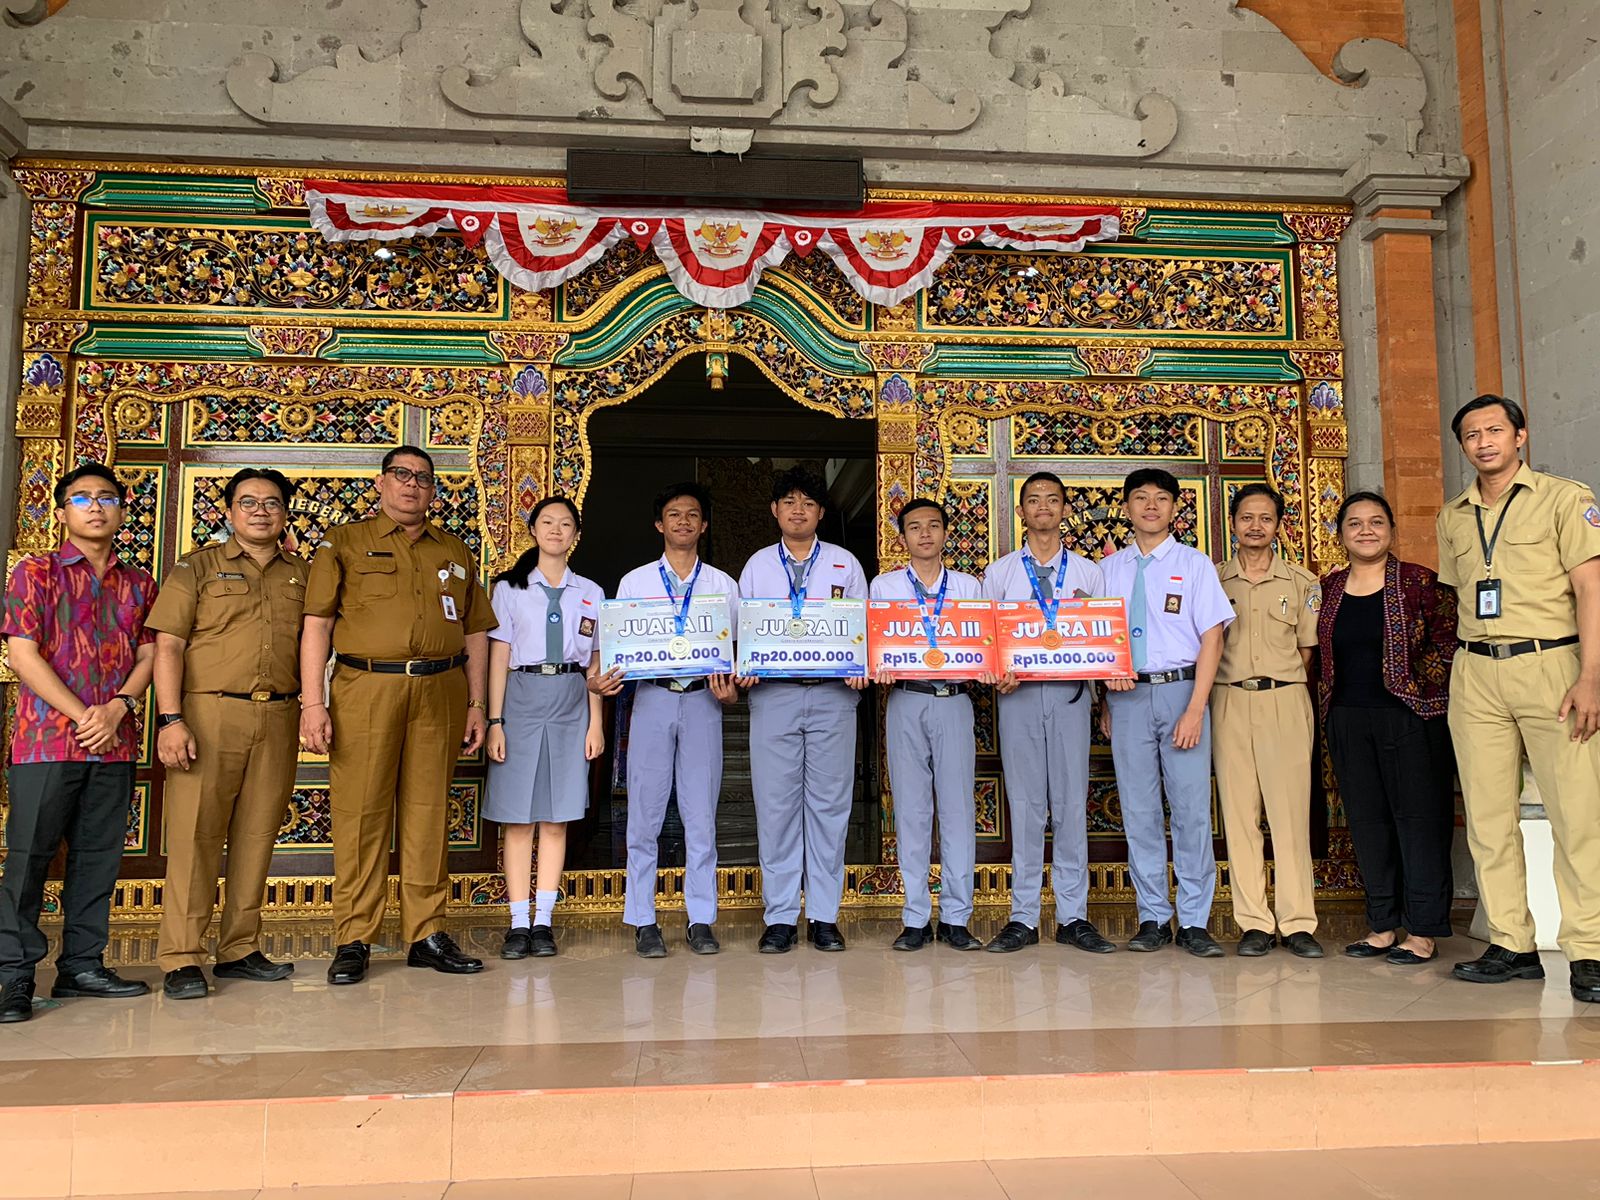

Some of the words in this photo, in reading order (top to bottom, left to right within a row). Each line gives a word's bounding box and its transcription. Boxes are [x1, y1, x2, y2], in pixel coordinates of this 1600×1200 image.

[1059, 510, 1093, 533] SMA
[619, 616, 696, 637] JUARA
[698, 615, 713, 632] II
[755, 619, 832, 637] JURA
[834, 619, 849, 636] II
[961, 621, 981, 637] III
[1091, 620, 1112, 637] III
[751, 650, 854, 665] Rp20.000.000
[883, 652, 983, 667] Rp15.0.000
[1013, 652, 1116, 668] Rp15.000.000
